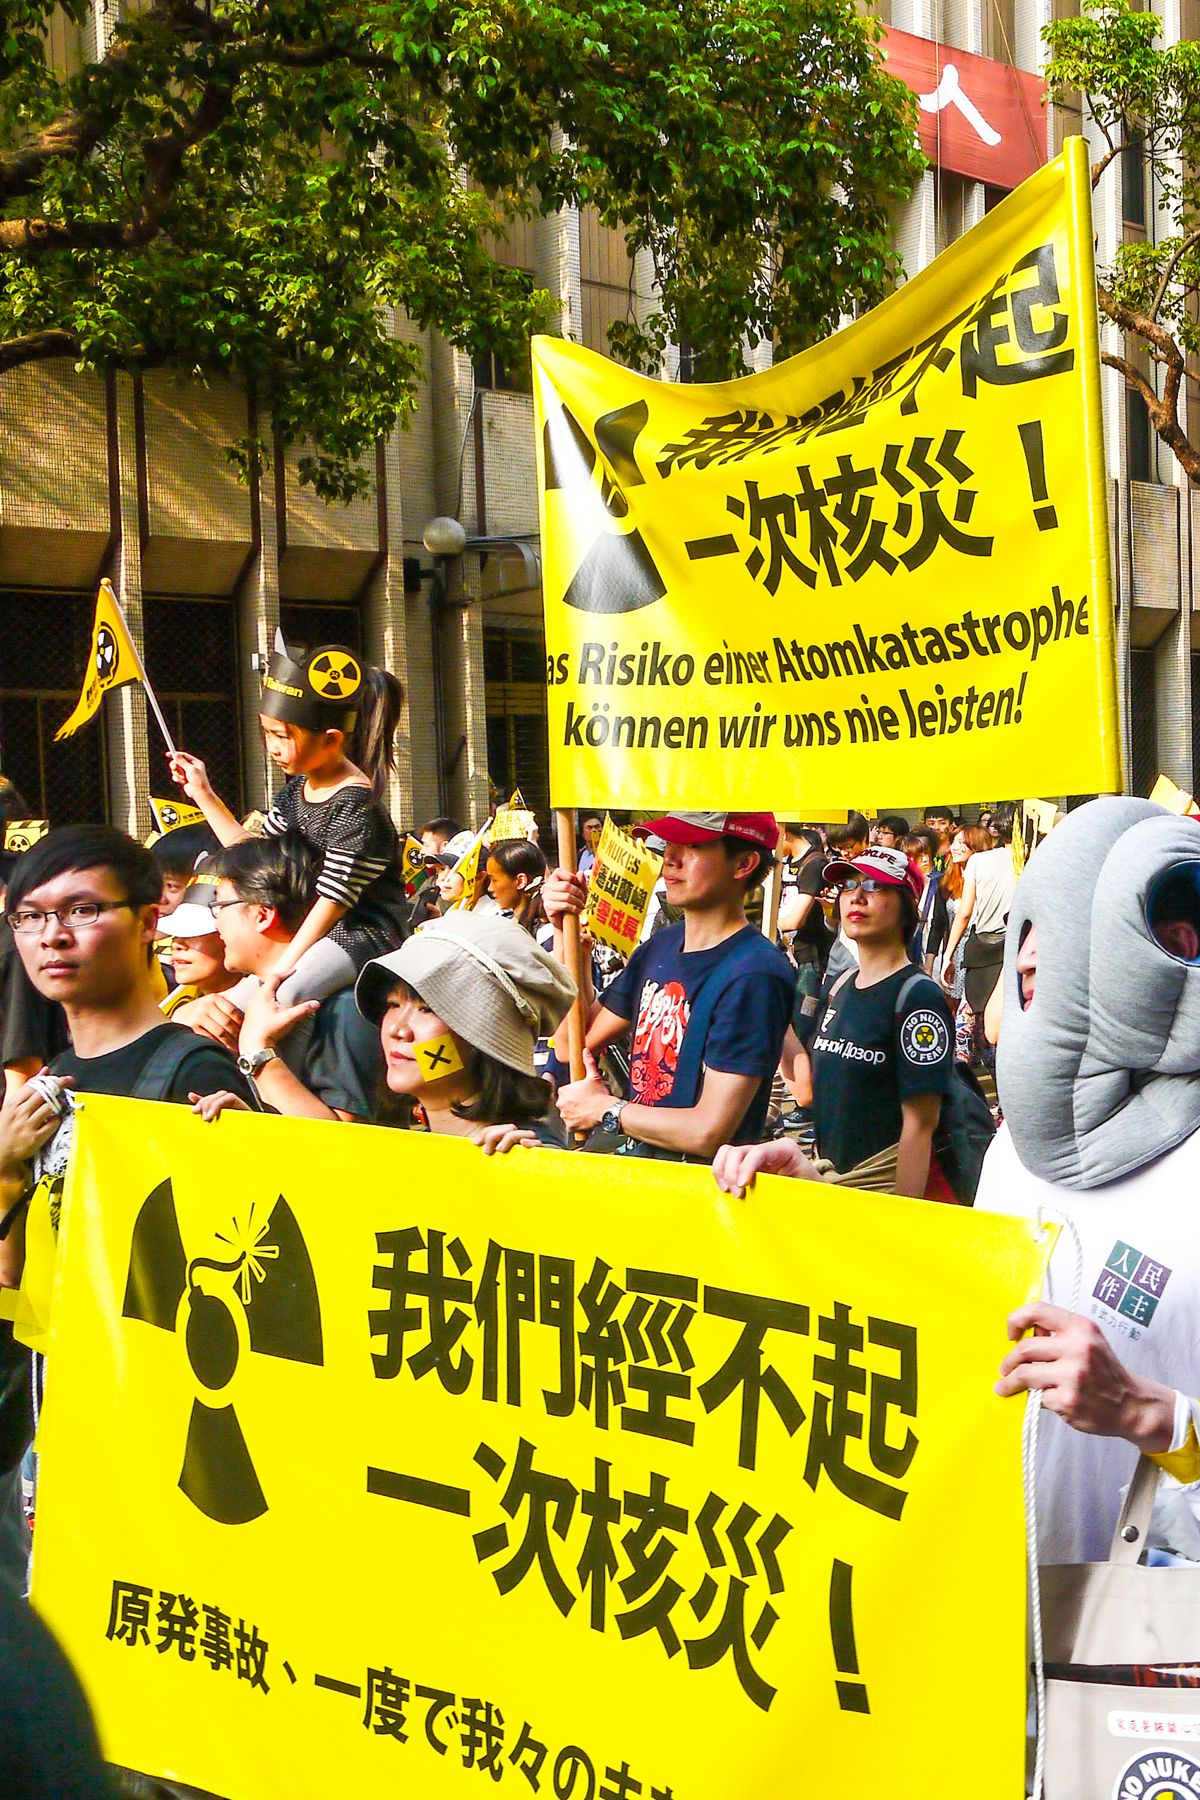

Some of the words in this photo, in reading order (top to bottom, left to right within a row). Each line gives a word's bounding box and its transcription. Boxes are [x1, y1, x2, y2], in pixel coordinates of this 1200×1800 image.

[578, 641, 695, 686] Risiko
[704, 639, 772, 685] einer
[773, 585, 1090, 683] Atomkatastrophe
[564, 702, 709, 748] können
[719, 702, 777, 748] wir
[783, 710, 841, 748] uns
[843, 694, 900, 743] nie
[899, 671, 1028, 738] leisten!
[906, 1017, 918, 1031] NO
[919, 1013, 944, 1034] NUKE
[905, 1045, 917, 1058] NO
[920, 1046, 943, 1061] FEAR
[1111, 1248, 1164, 1292] 人民
[1099, 1275, 1149, 1321] 作主
[368, 1225, 919, 1521] 我們經不起
